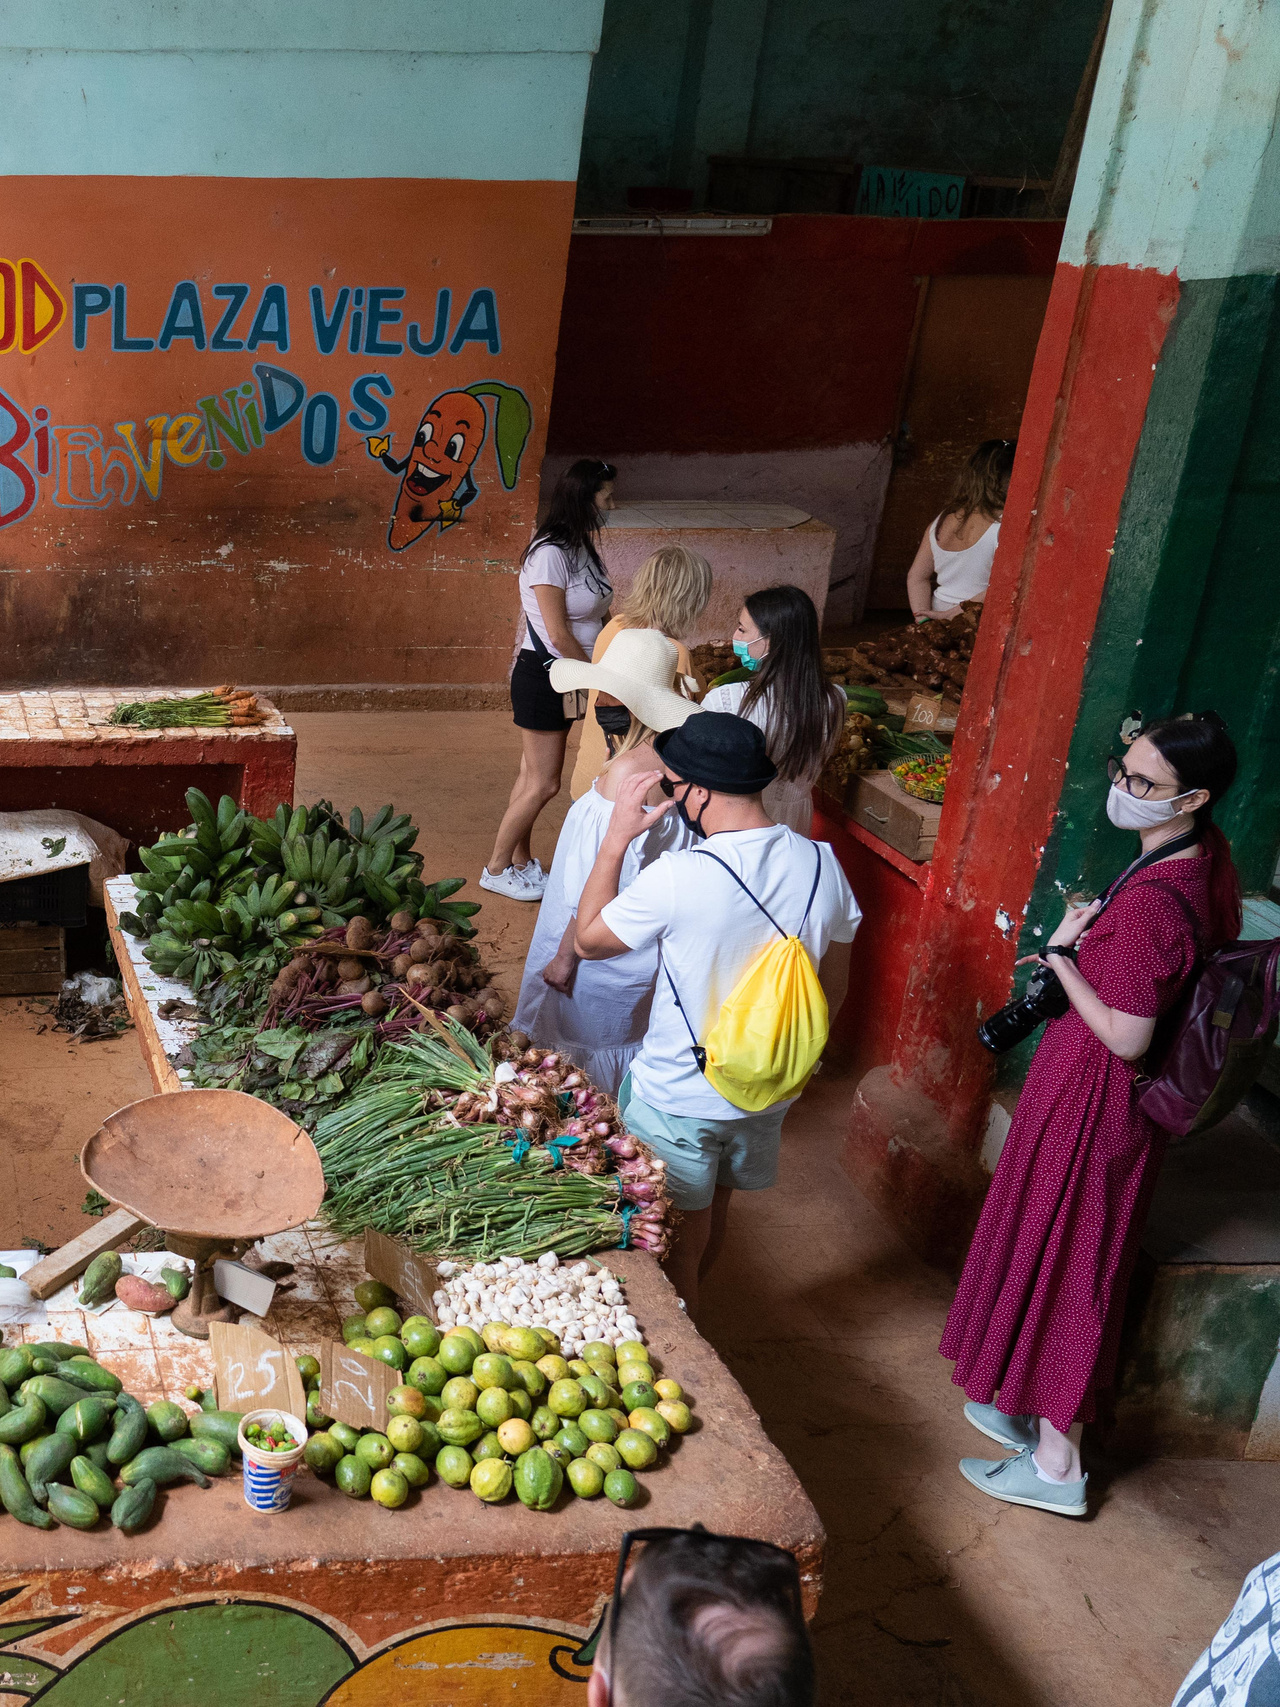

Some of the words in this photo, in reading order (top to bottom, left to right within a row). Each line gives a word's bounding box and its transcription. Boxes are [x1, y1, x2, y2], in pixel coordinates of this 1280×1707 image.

[72, 280, 290, 354] PLAZA
[909, 703, 934, 725] 100
[225, 1349, 283, 1401] 25
